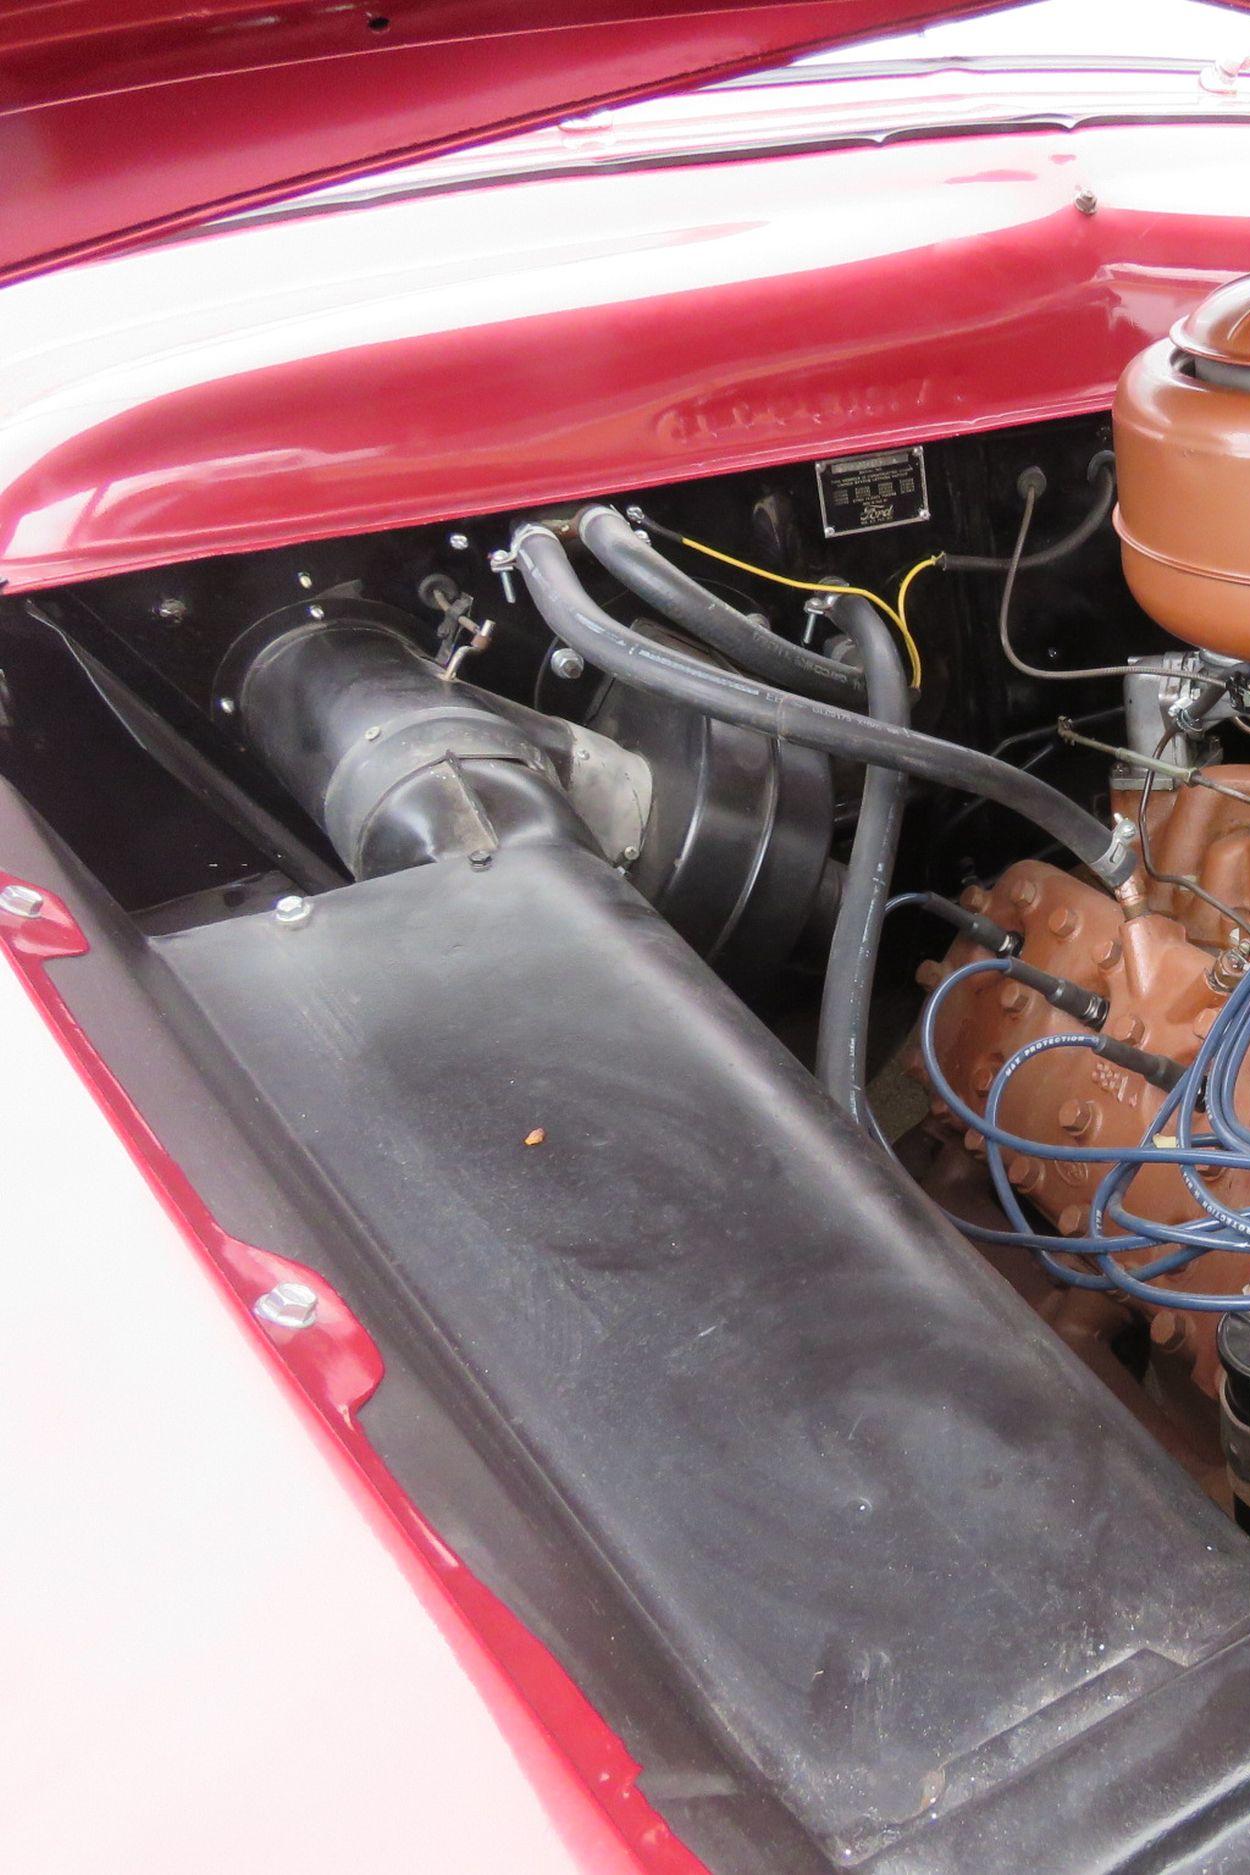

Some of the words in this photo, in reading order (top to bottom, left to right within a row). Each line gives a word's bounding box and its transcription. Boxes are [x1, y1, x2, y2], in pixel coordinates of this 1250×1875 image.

[859, 503, 896, 522] Ford
[1004, 1056, 1022, 1078] MAX
[1023, 1034, 1086, 1058] PROTECTION
